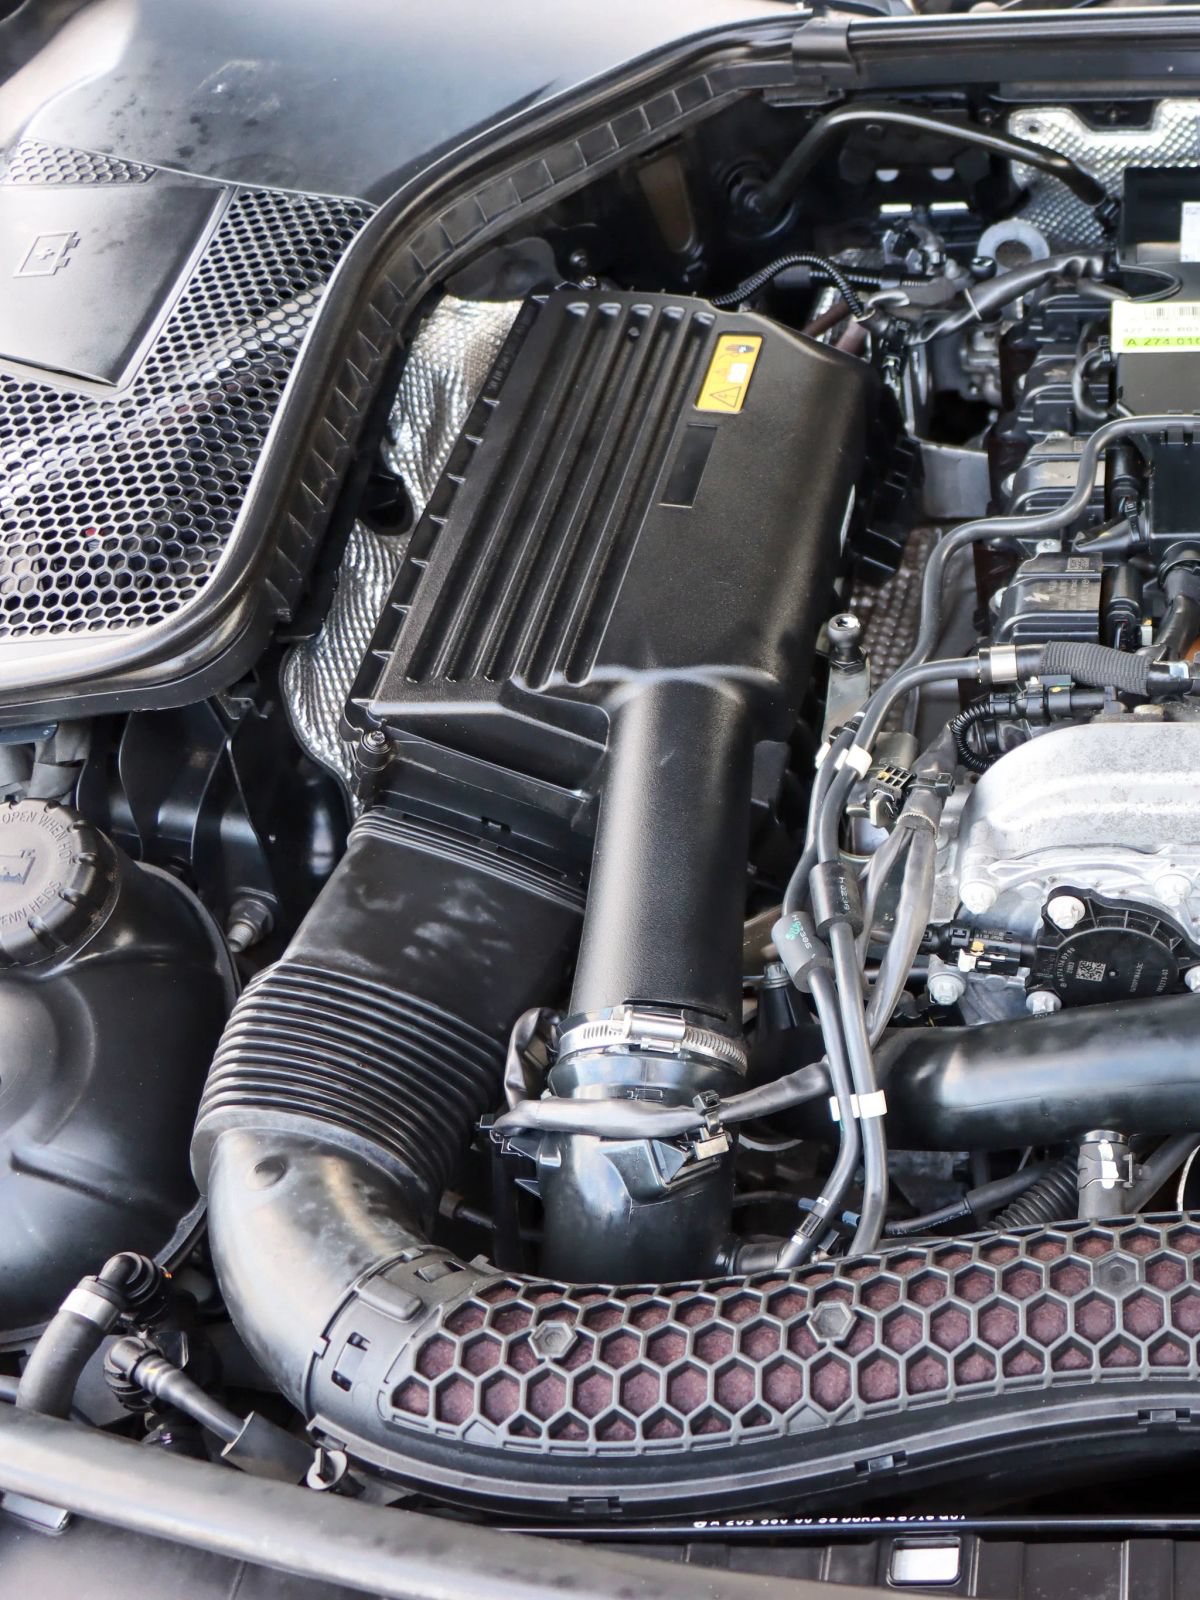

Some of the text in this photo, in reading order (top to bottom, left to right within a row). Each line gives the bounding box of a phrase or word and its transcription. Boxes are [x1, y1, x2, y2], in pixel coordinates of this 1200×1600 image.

[1126, 338, 1137, 347] A
[1143, 337, 1170, 346] 274
[2, 811, 37, 824] OPEN
[38, 814, 68, 844] WHEN
[1, 880, 61, 926] ENN HEISS
